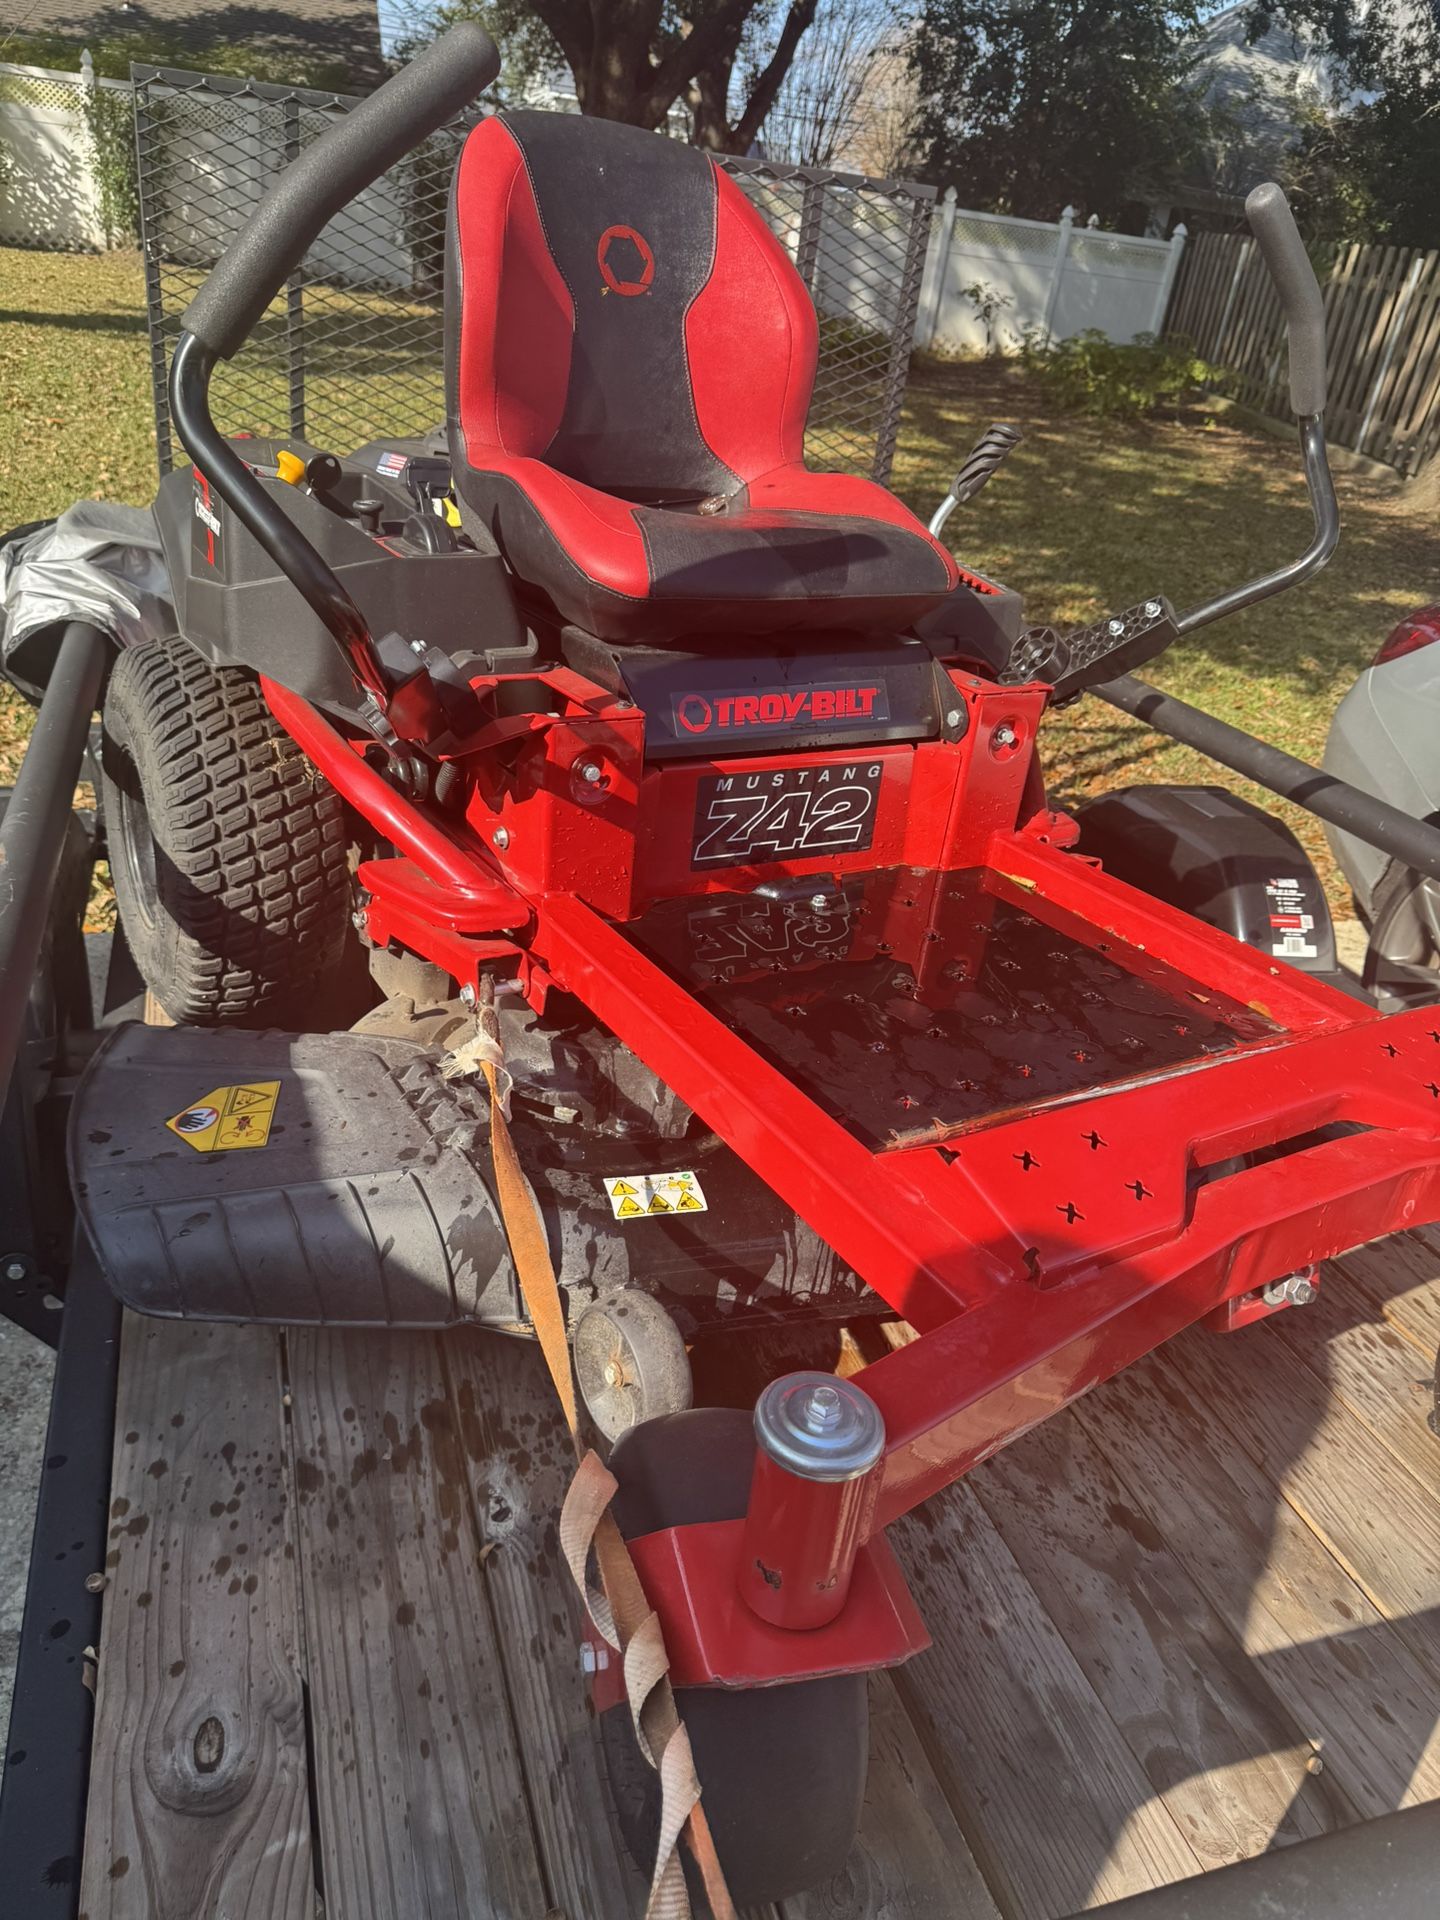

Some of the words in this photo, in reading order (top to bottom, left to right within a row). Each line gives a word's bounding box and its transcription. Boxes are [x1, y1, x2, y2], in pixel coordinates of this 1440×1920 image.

[713, 687, 878, 728] TROY-BILT
[716, 764, 881, 792] MUSTANG
[693, 785, 872, 862] Z42
